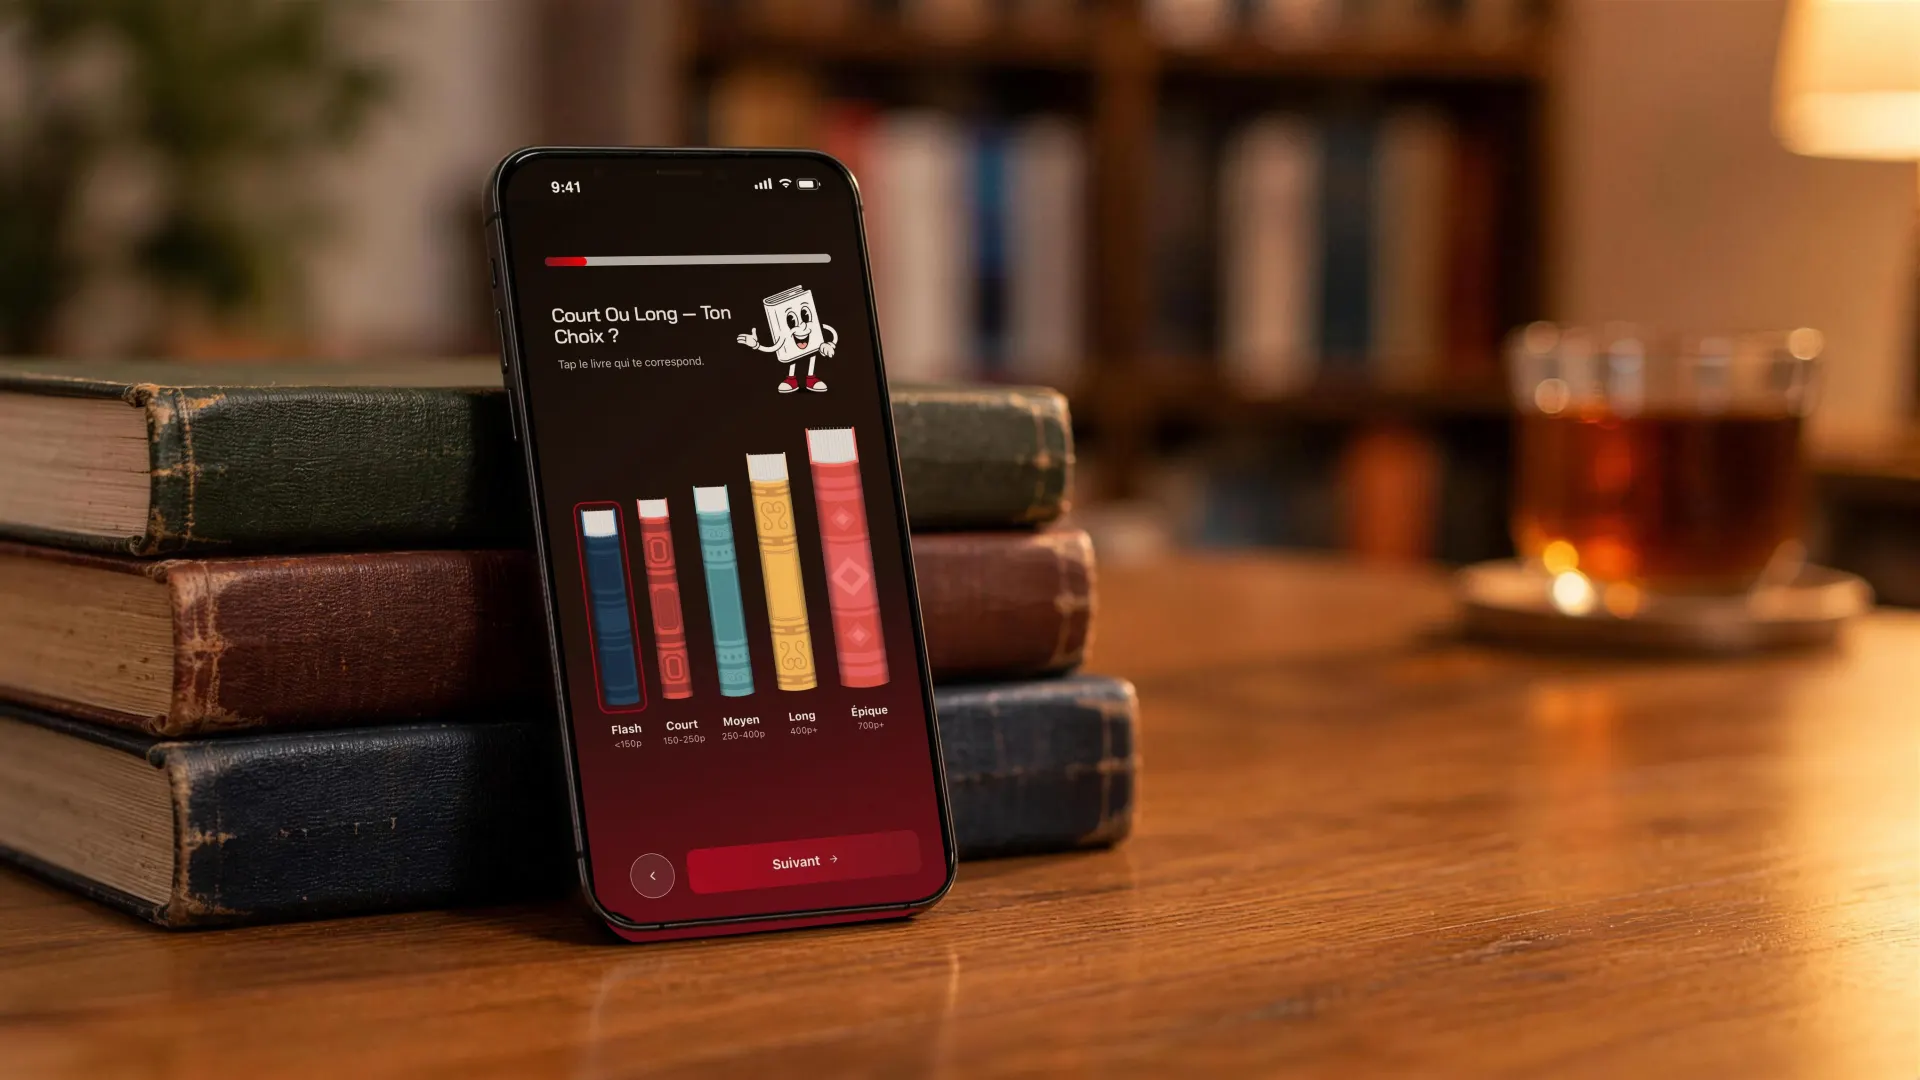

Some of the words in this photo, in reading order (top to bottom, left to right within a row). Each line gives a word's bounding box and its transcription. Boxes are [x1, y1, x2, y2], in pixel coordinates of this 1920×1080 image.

[550, 180, 581, 194] 9:41
[551, 307, 602, 324] Court
[604, 306, 630, 322] Ou
[633, 306, 679, 325] Long
[699, 305, 732, 320] Ton
[554, 328, 605, 345] Choix
[607, 327, 619, 343] ?
[557, 359, 577, 371] Tap
[578, 359, 589, 369] le
[590, 358, 612, 369] livre
[613, 357, 630, 370] qui
[631, 358, 643, 368] te
[644, 355, 705, 368] correspond.
[788, 712, 816, 723] Long
[850, 704, 889, 719] Épique
[665, 719, 699, 731] Court
[722, 716, 760, 728] Moyen
[857, 721, 885, 731] 700p+
[611, 723, 643, 735] Flash
[721, 729, 766, 741] 250-400p
[790, 726, 818, 736] 400p+
[614, 739, 643, 749] <150p
[663, 734, 706, 745] 150-250p
[772, 855, 821, 870] Suivant
